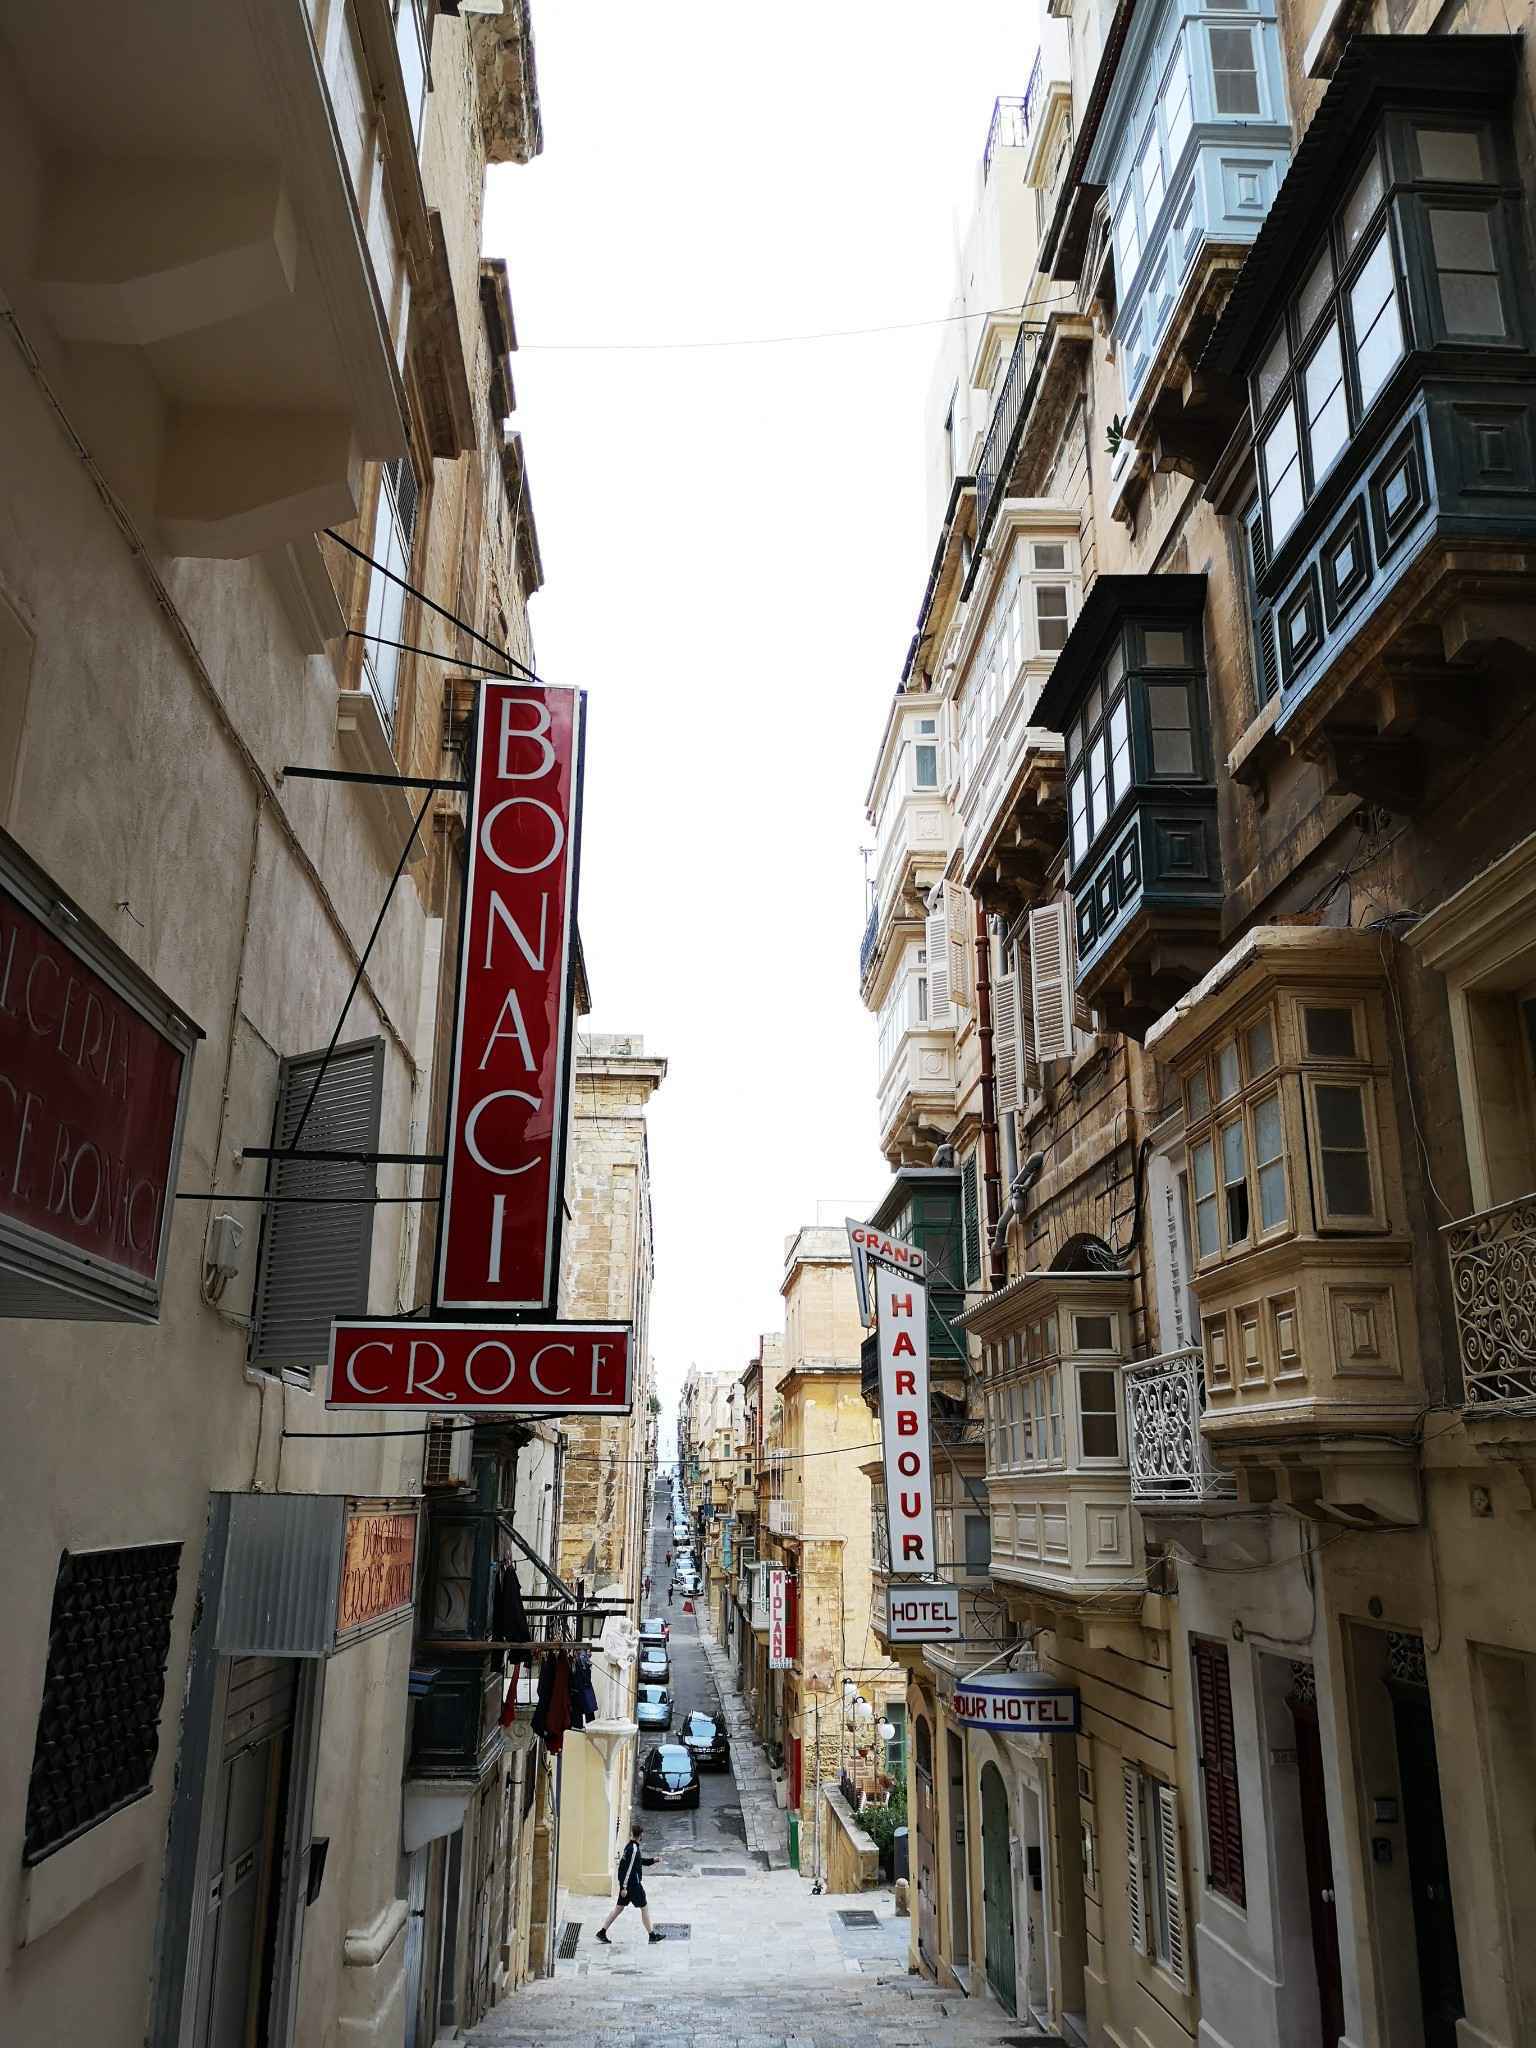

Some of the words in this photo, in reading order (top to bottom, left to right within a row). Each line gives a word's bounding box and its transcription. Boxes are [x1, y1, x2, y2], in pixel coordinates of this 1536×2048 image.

[0, 924, 130, 1101] LCERIA
[464, 696, 566, 1284] BONACI
[852, 1228, 922, 1267] GRAND
[346, 1340, 615, 1401] CROCE
[891, 1292, 925, 1562] HARBOUR
[772, 1571, 783, 1658] MIDLAND
[891, 1600, 958, 1622] HOTEL
[992, 1698, 1068, 1722] HOTEL
